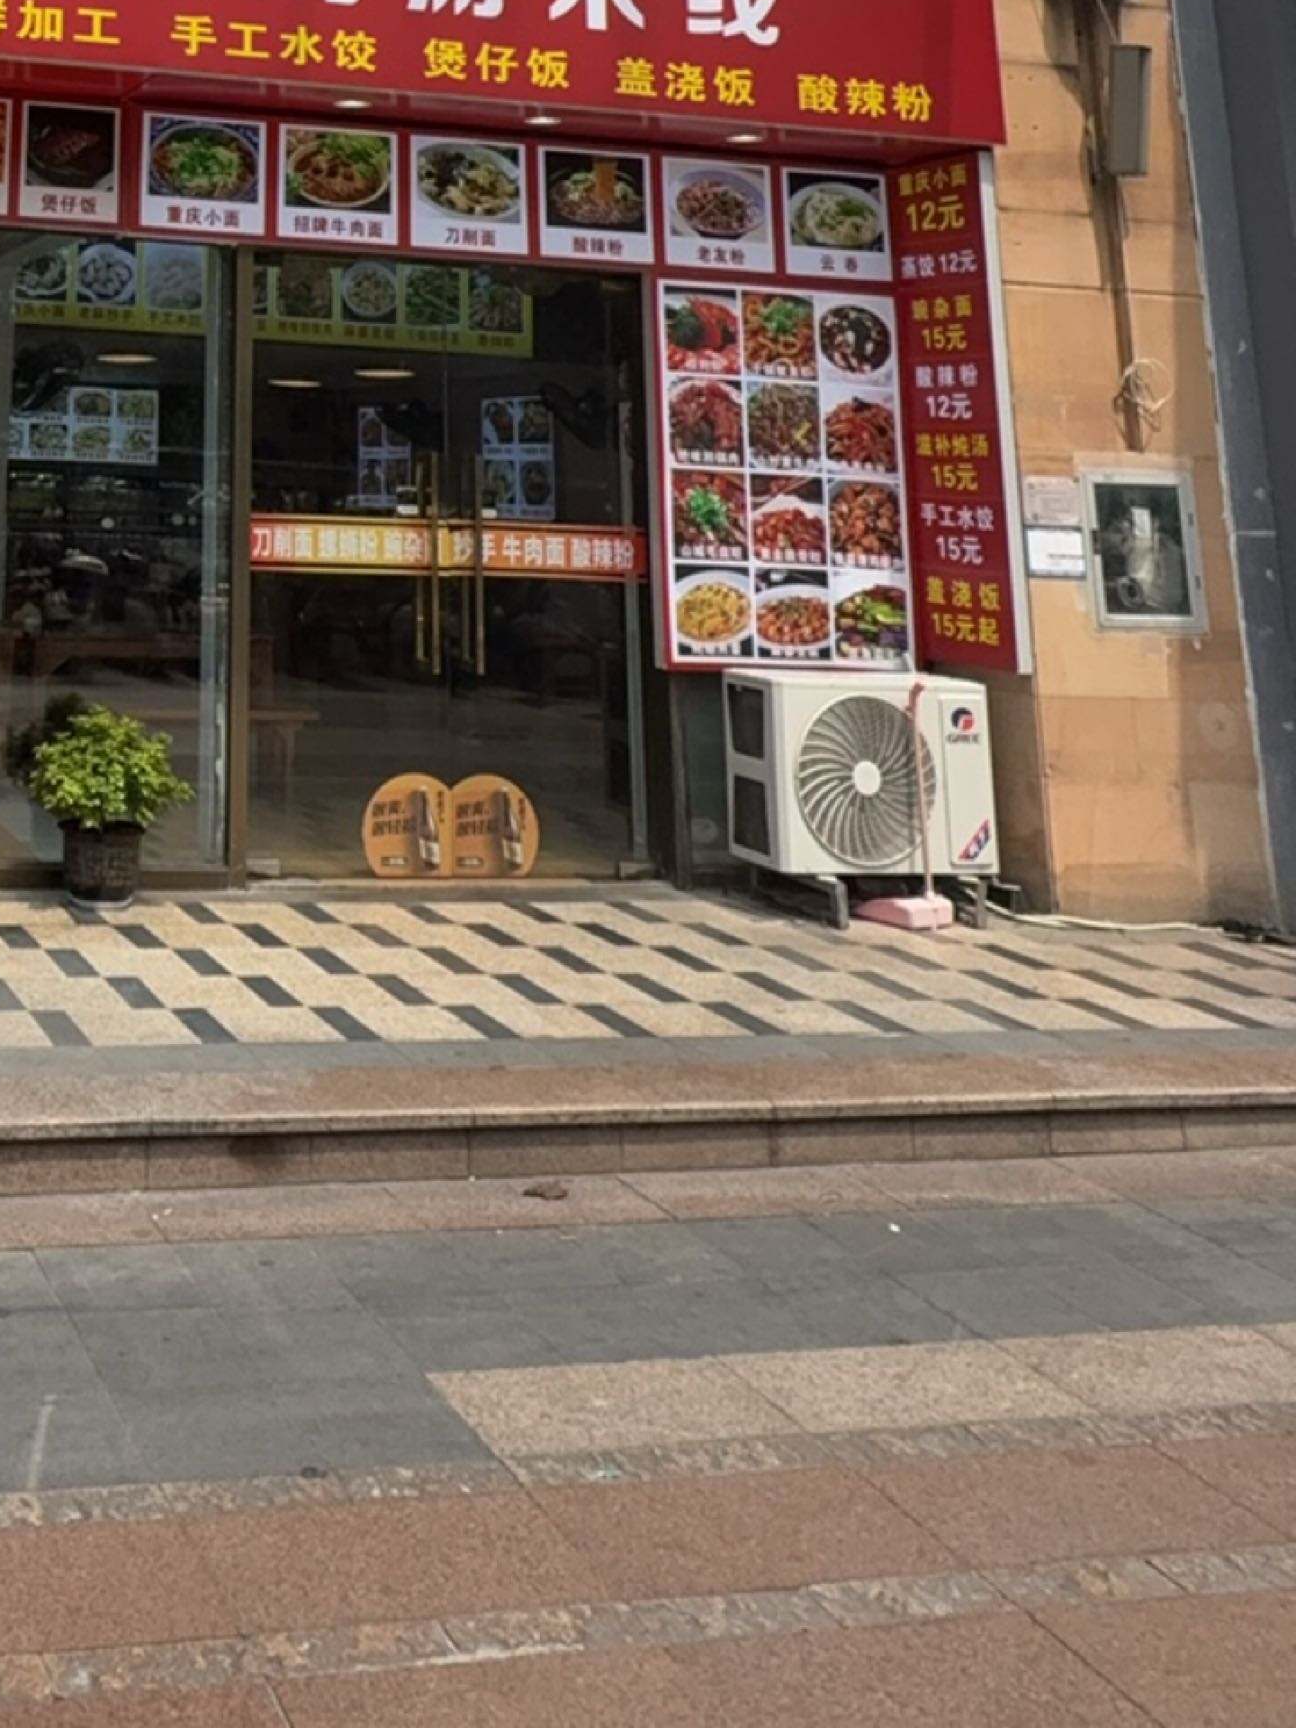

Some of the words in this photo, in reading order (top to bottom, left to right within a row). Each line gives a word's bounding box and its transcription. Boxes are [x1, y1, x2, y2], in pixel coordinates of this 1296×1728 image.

[170, 13, 377, 75] 手工水饺
[422, 37, 570, 91] 煲仔饭
[615, 57, 757, 110] 盖浇饭
[797, 73, 934, 123] 酸辣粉
[898, 163, 968, 197] 重庆小面
[40, 193, 98, 216] 煲仔饭
[166, 206, 242, 229] 重庆小面
[905, 195, 966, 233] 12元
[444, 227, 497, 247] 刀削面
[939, 249, 979, 274] 12元
[921, 323, 969, 351] 15元
[926, 394, 974, 421] 12元
[930, 464, 979, 491] 15元
[919, 503, 996, 532] 手工水饺
[251, 527, 314, 559] 刀削面
[502, 534, 566, 568] 牛肉面
[570, 536, 635, 570] 酸辣粉
[935, 536, 985, 566] 15元
[930, 612, 1001, 648] 15元起
